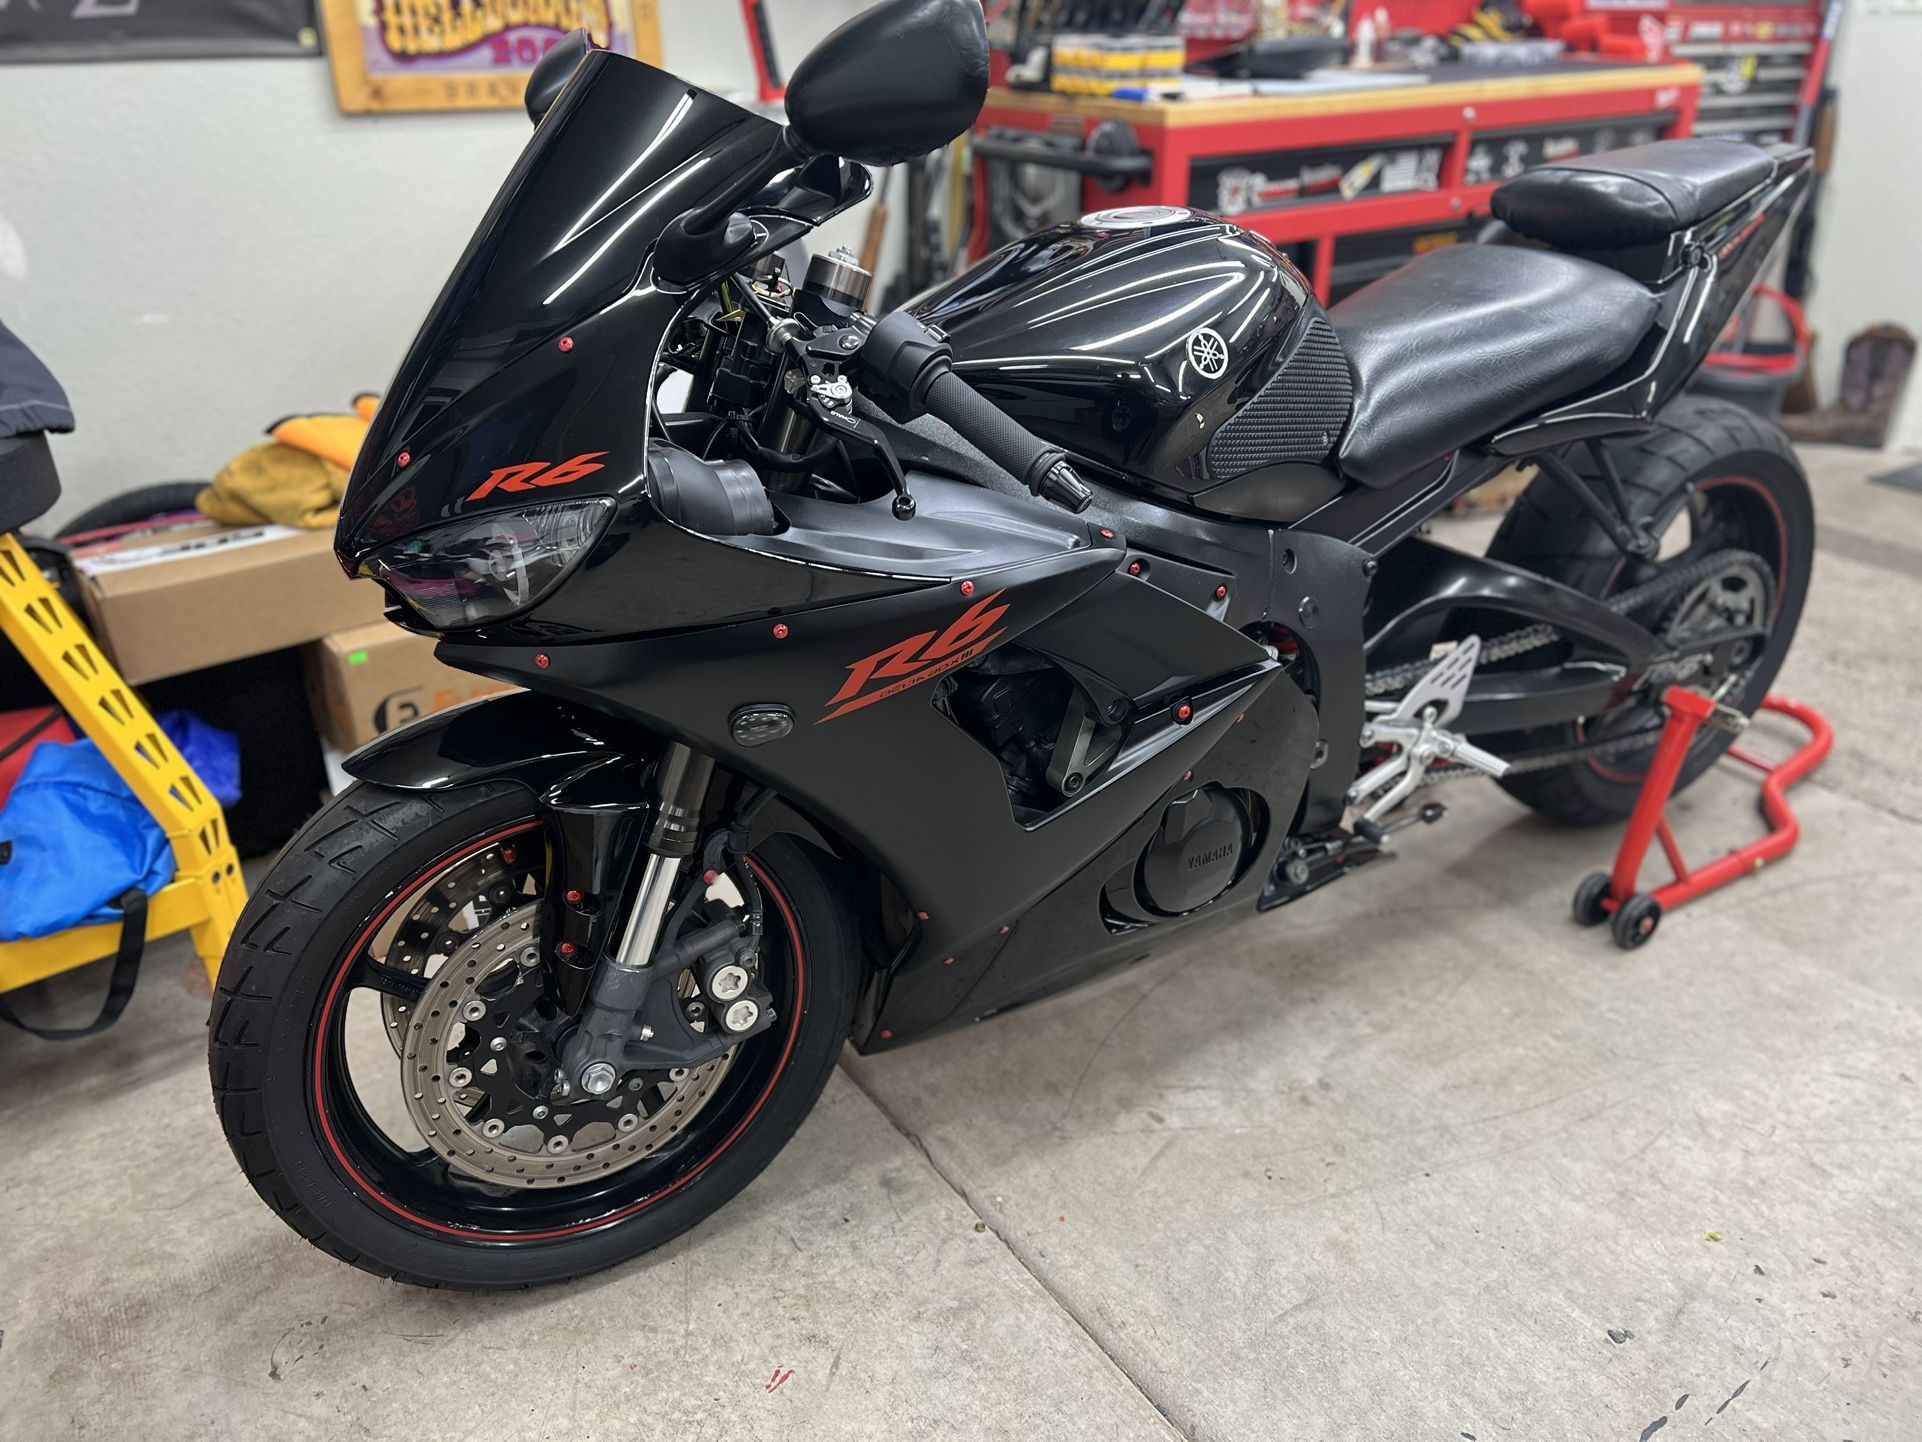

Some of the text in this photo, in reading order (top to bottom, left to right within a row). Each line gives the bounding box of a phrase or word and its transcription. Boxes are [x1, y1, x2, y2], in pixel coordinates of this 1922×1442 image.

[466, 451, 609, 502] R6
[824, 587, 1011, 706] R6
[1188, 842, 1233, 869] YAMAHA
